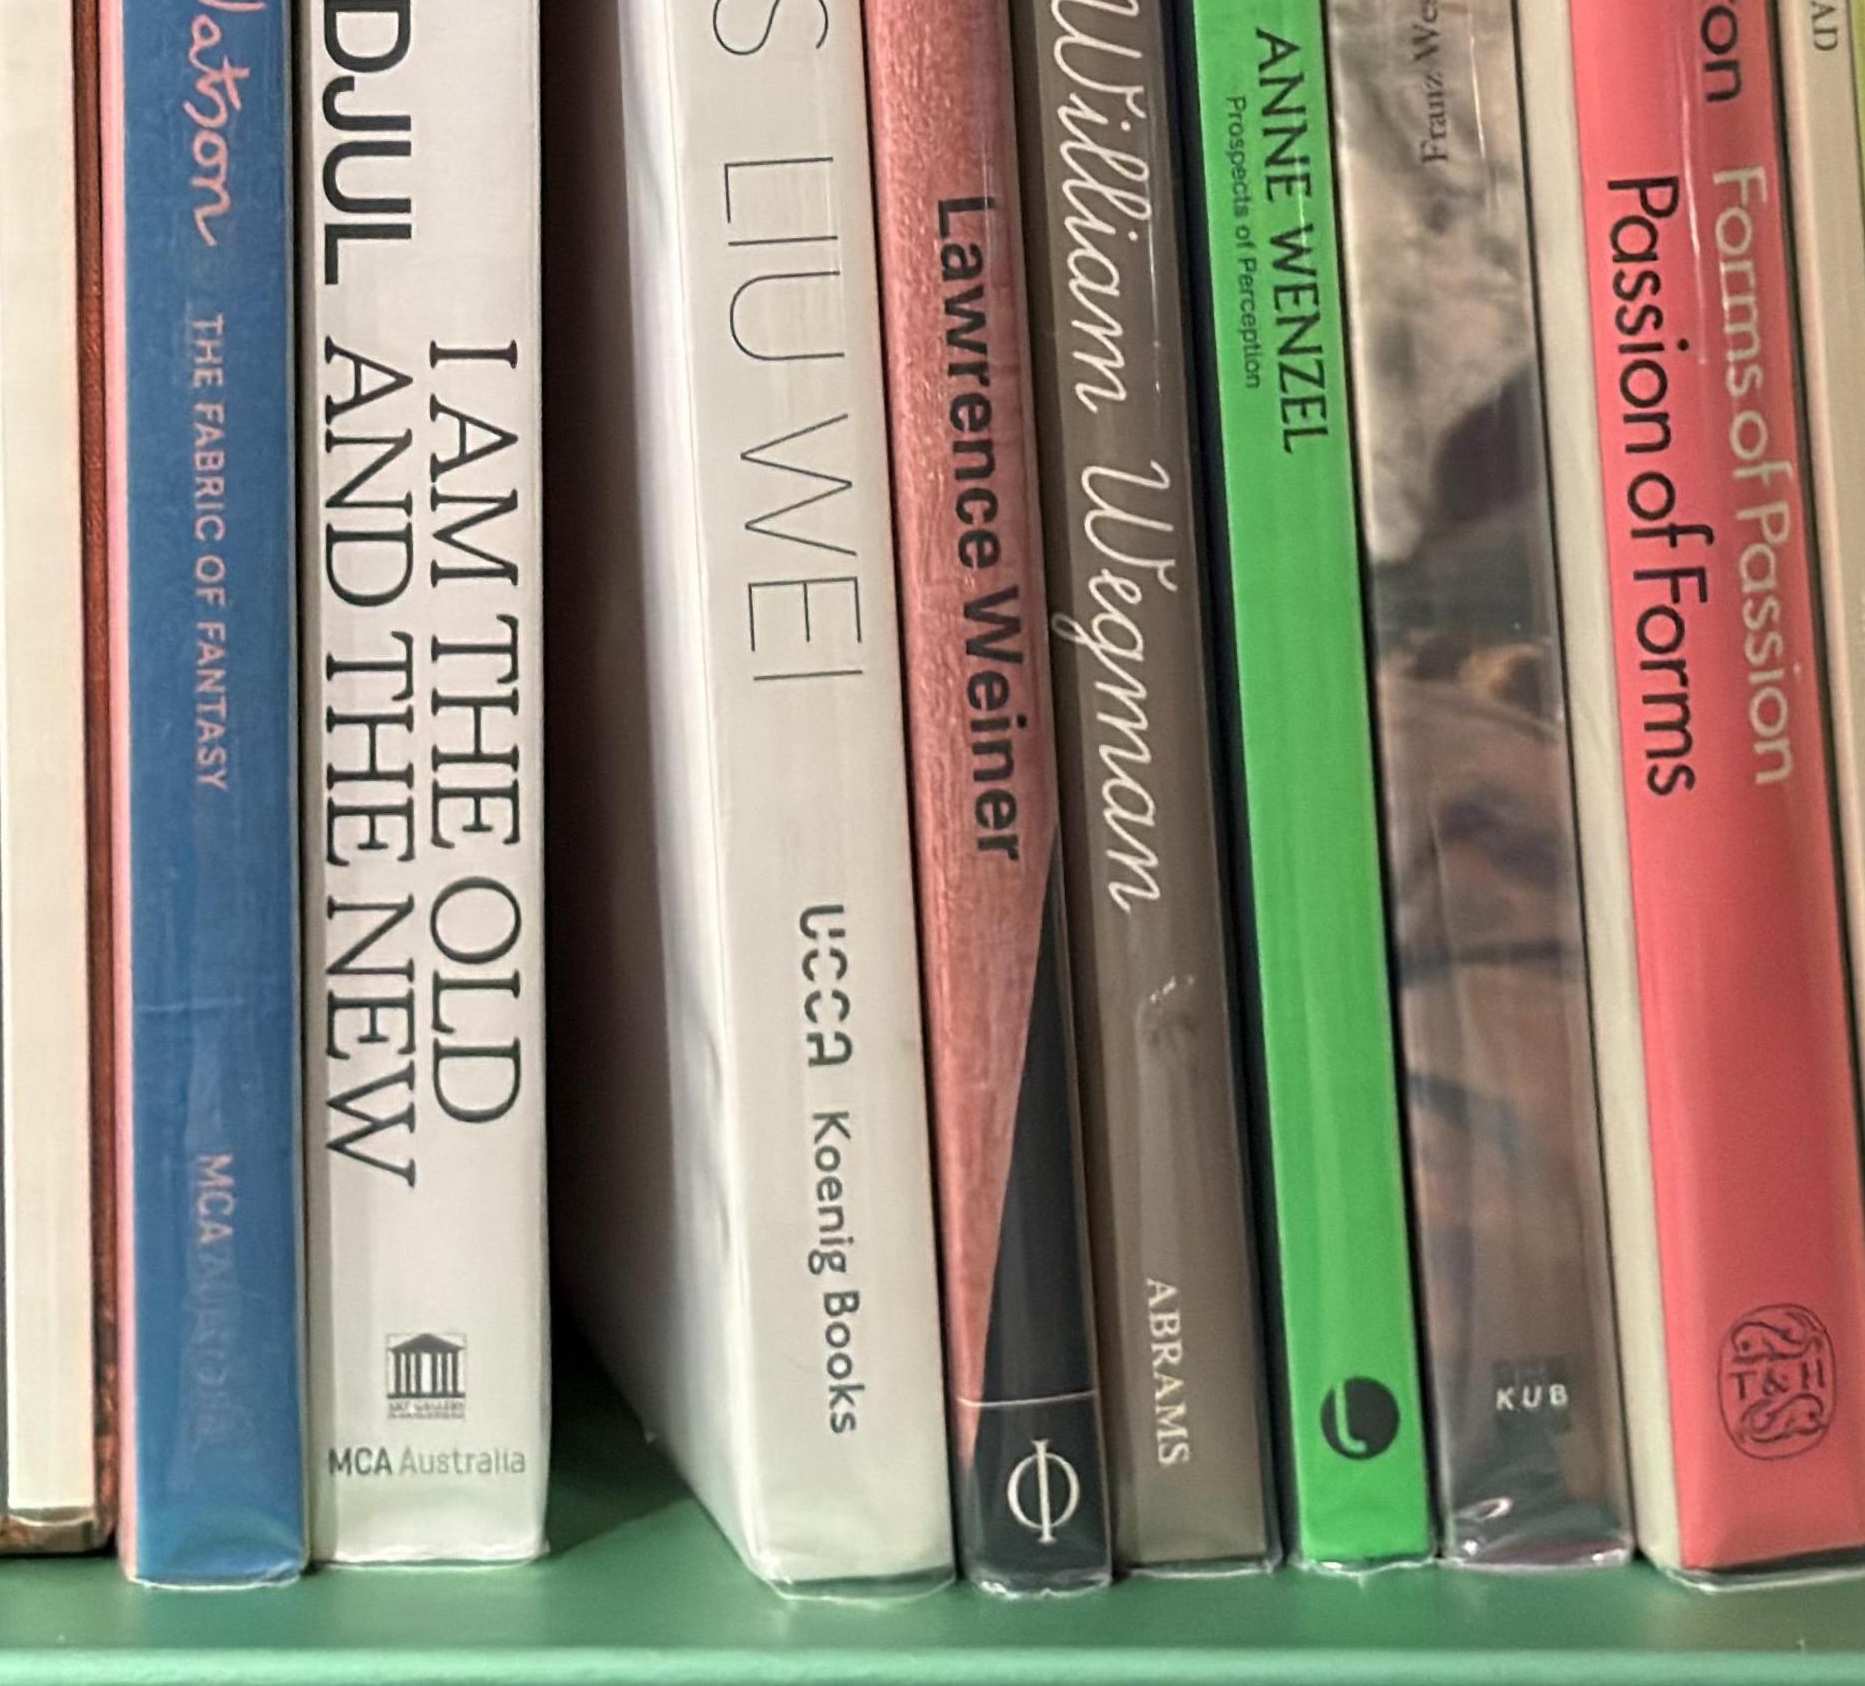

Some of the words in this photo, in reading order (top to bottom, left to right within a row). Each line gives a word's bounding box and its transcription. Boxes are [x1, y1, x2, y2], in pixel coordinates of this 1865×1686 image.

[1224, 94, 1255, 219] Prospects
[1253, 24, 1314, 207] ANNE
[1416, 73, 1452, 166] Franz
[721, 155, 847, 364] LIU
[1232, 225, 1258, 252] of
[1234, 257, 1266, 389] Perception
[1607, 173, 1691, 455] Passion
[1711, 164, 1772, 398] Forms
[190, 314, 226, 390] THE
[428, 336, 520, 372] I
[936, 192, 1003, 571] Lawrence
[1266, 222, 1330, 455] WENZEL
[192, 401, 227, 542] FABRIC
[323, 335, 415, 609] AND
[428, 392, 520, 591] AM
[1626, 468, 1716, 548] of
[1726, 410, 1795, 489] of
[193, 553, 228, 608] OF
[739, 412, 865, 685] WEI
[194, 619, 232, 793] FANTASY
[428, 612, 522, 851] THE
[961, 584, 1028, 864] Weiner
[1050, 457, 1181, 915] Wegman
[1632, 564, 1711, 797] Forms
[1734, 498, 1804, 788] Passion
[323, 631, 417, 867] THE
[323, 894, 417, 1190] NEW
[430, 874, 522, 1126] OLD
[195, 1152, 236, 1246] MCA
[806, 1109, 856, 1277] Koenig
[821, 1289, 866, 1437] Books
[1142, 1276, 1192, 1469] ABRAMS
[1494, 1383, 1571, 1412] KUB
[328, 1446, 393, 1476] MCA
[398, 1445, 527, 1476] Australia
